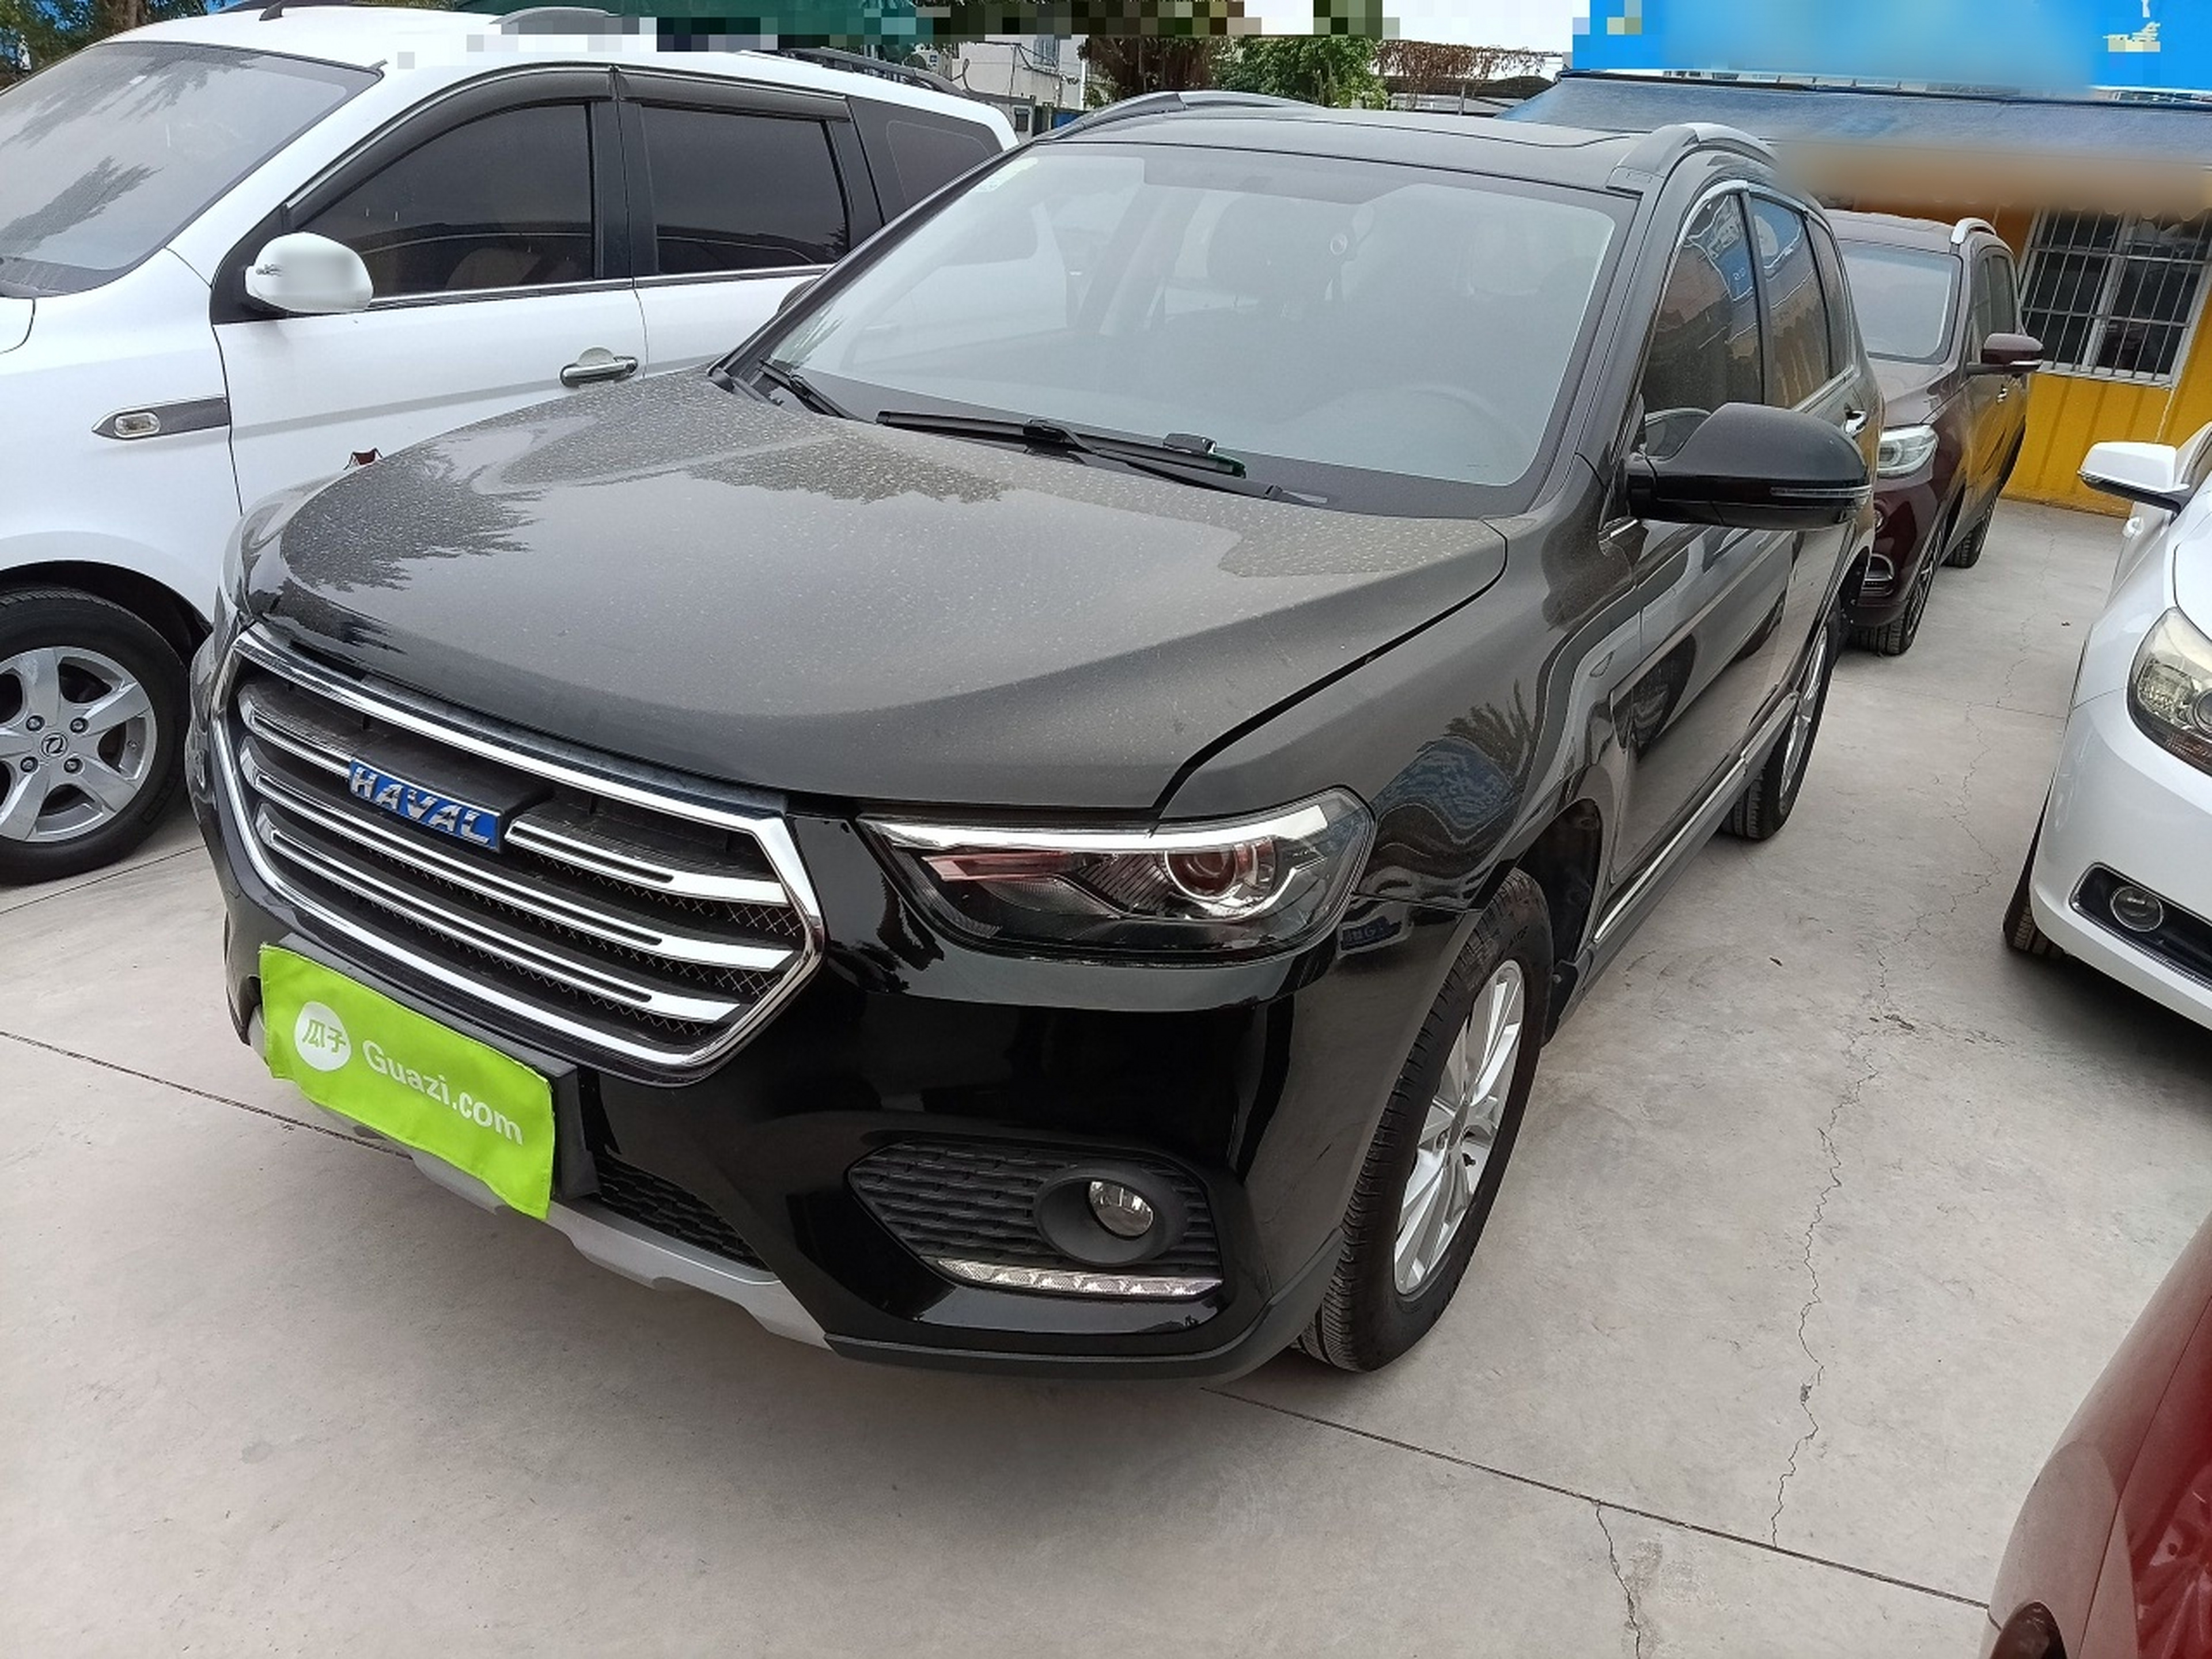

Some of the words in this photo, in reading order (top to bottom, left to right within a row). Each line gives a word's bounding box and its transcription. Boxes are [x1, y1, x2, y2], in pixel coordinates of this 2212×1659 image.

[350, 766, 490, 844] HAVAL
[301, 1018, 347, 1054] 瓜子
[362, 1039, 524, 1146] Guazi.com
